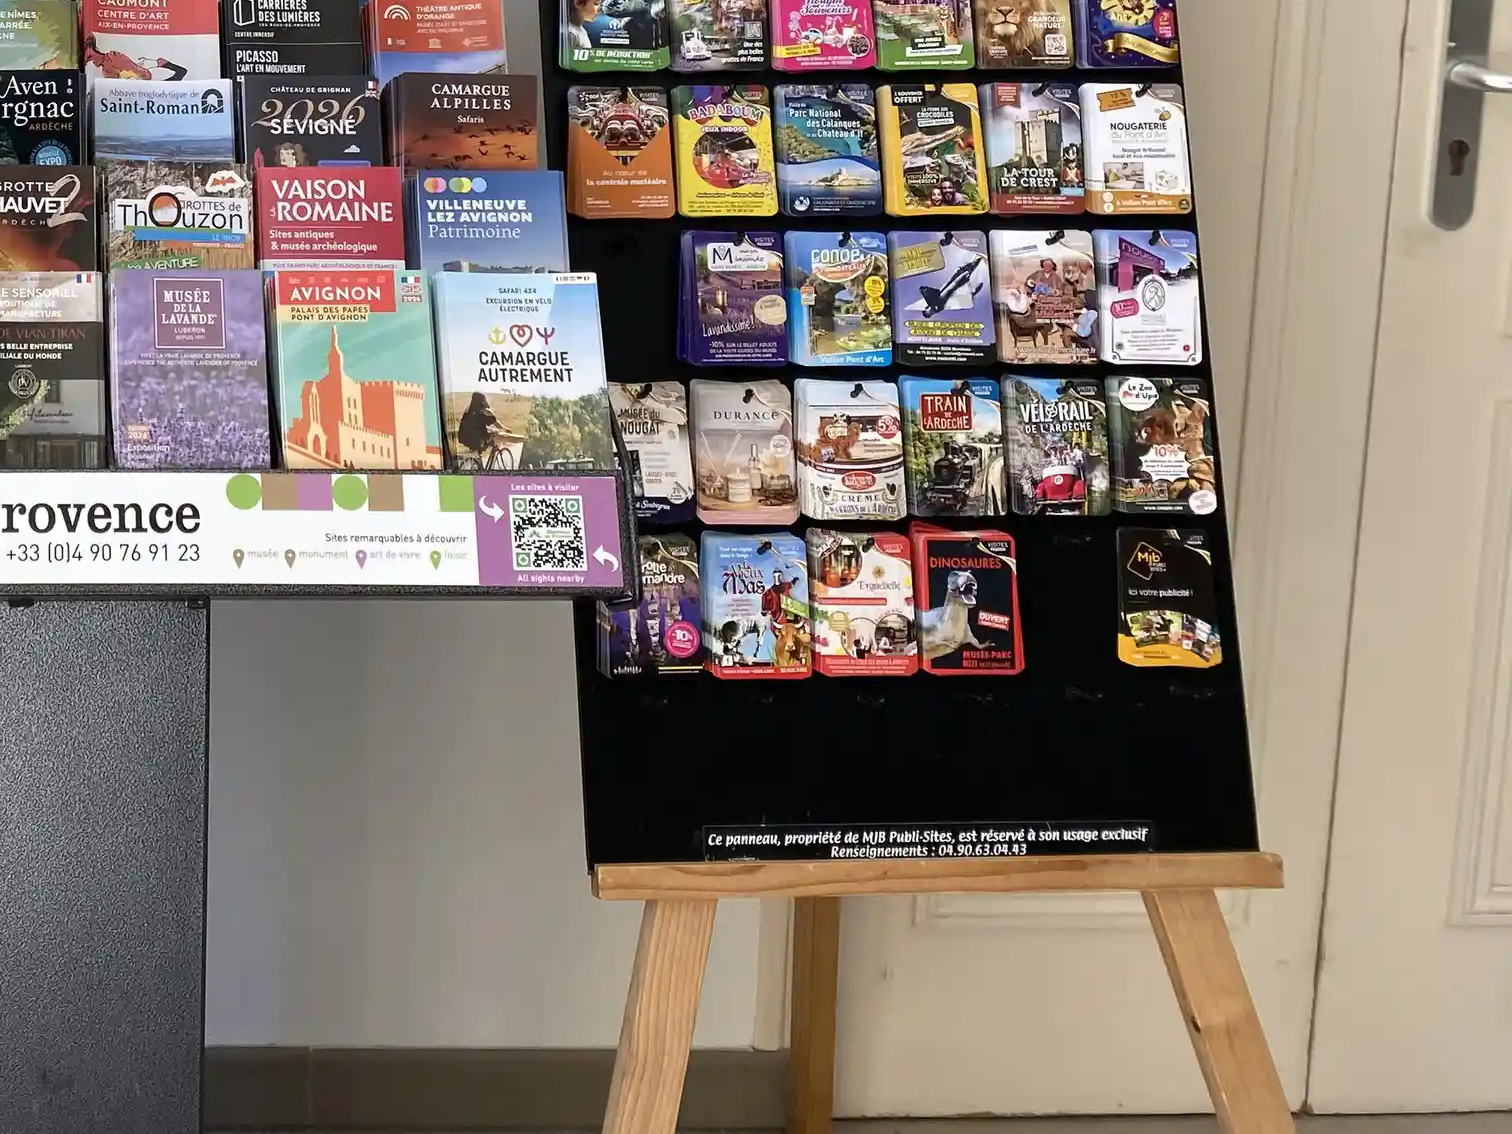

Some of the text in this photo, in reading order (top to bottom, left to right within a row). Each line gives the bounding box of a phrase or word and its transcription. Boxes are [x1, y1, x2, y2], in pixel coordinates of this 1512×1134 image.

[97, 9, 170, 20] CENTRE D'ART
[258, 8, 321, 22] DES LUMIÈRES
[800, 5, 851, 16] Souvenirs
[98, 21, 170, 30] AIX-EN-PROVENCE
[237, 50, 278, 63] PICASSO
[0, 75, 58, 98] Aven
[431, 83, 510, 96] CAMARGUE
[100, 98, 199, 115] Saint-Roman
[430, 97, 511, 110] ALPILLES
[894, 96, 922, 104] OFFERT
[789, 108, 841, 118] Parc National
[270, 114, 357, 135] SÉVIGNÉ
[806, 119, 861, 130] des Calanques
[1110, 122, 1167, 131] NOUGATERIE
[1003, 167, 1054, 178] LA TOUR
[1001, 177, 1059, 188] DE CREST
[271, 179, 366, 200] VAISON
[426, 199, 526, 211] VILLENEUVE
[277, 202, 394, 222] ROMAINE
[427, 212, 533, 223] LEZ AVIGNON
[270, 229, 335, 241] Sites antiques
[428, 224, 521, 239] Patrimoine
[811, 246, 858, 264] canoë
[12, 287, 78, 298] SENSORIEL
[163, 287, 210, 303] MUSÉE
[291, 286, 381, 301] AVIGNON
[479, 351, 569, 366] CAMARGUE
[478, 368, 573, 383] AUTREMENT
[924, 395, 967, 413] TRAIN
[620, 408, 660, 420] MUSÉE du
[620, 421, 660, 435] NOUGAT
[878, 419, 899, 432] 5%
[1153, 445, 1179, 458] 10%
[511, 483, 525, 491] Les
[527, 483, 546, 491] sites
[555, 483, 580, 492] visiter
[325, 533, 348, 543] Sites
[350, 533, 414, 545] remarquables
[424, 533, 467, 544] découvrir
[6, 544, 40, 562] +33
[47, 542, 83, 563] (0)4
[90, 544, 112, 562] 90
[120, 544, 141, 562] 76
[149, 544, 169, 562] 91
[178, 544, 200, 562] 23
[248, 549, 467, 560] musée monument art de vivre loisir
[930, 557, 1002, 569] DINOSAURES
[517, 574, 585, 584] All sights nearby
[858, 580, 901, 591] Eyguebelle
[708, 826, 1149, 848] Ce panneau, propriété de MJB Publi-Sites, est réservé à son usage exclusif
[830, 844, 927, 859] Renseignements
[938, 843, 1027, 857] 04.90.63.04.43
